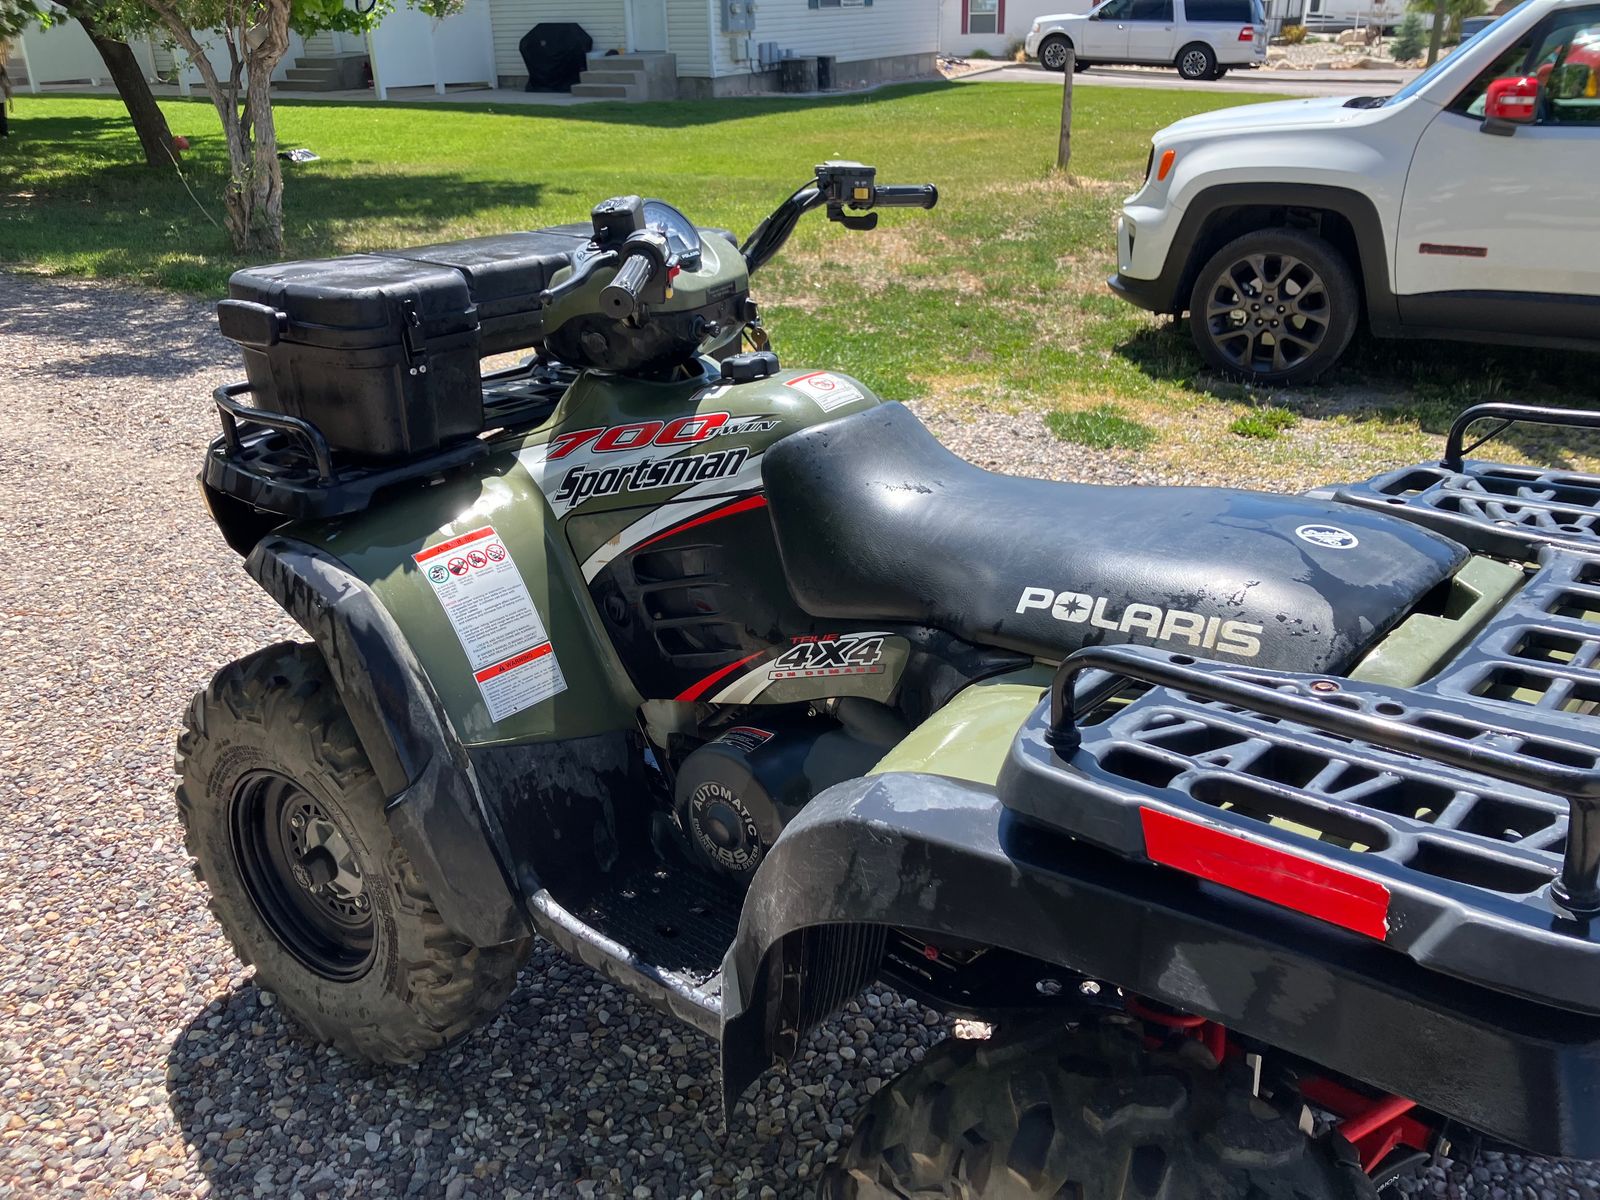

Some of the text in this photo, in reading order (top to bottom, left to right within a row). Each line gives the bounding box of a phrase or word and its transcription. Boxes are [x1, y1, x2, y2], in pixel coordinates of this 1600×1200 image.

[545, 411, 782, 460] 700 TWIN
[553, 447, 751, 509] Sportsman
[1015, 586, 1264, 657] POLARIS
[774, 637, 885, 670] 4X4
[804, 666, 878, 676] DEMAND
[693, 784, 757, 837] AUTOMATIC
